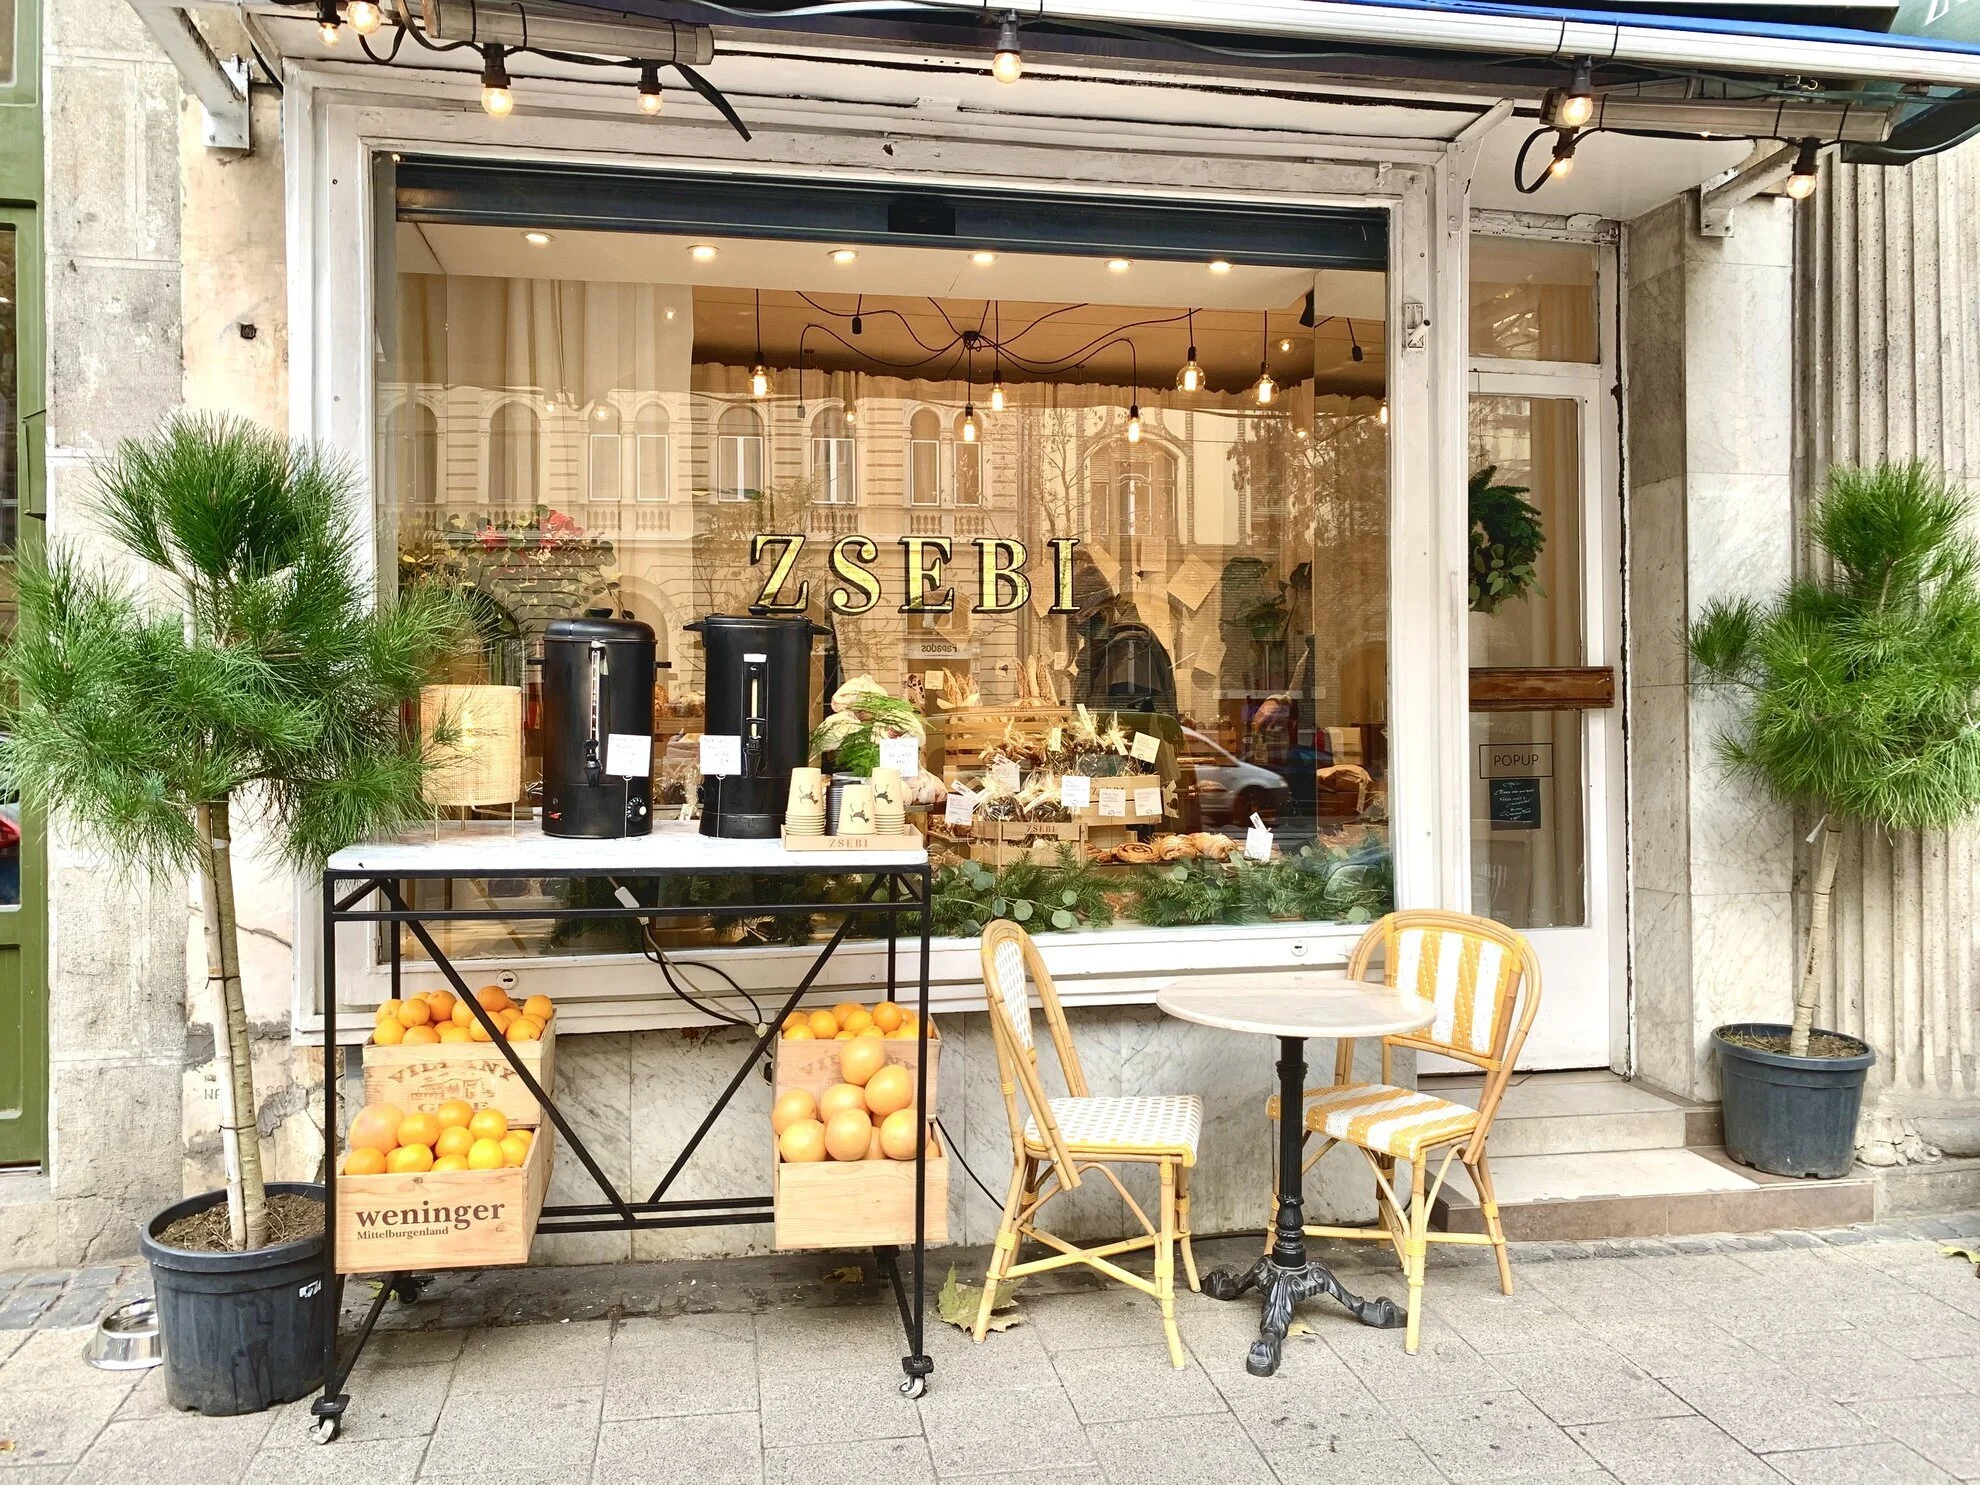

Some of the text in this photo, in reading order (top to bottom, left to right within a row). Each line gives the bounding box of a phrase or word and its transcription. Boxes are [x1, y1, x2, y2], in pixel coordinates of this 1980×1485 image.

[750, 534, 1081, 615] ZSEBI
[1493, 754, 1539, 767] POPUP
[1026, 824, 1056, 833] ZSEBI
[828, 838, 869, 849] ZSEBI
[355, 1200, 506, 1231] weninger
[356, 1226, 450, 1240] Mittelburgenland
